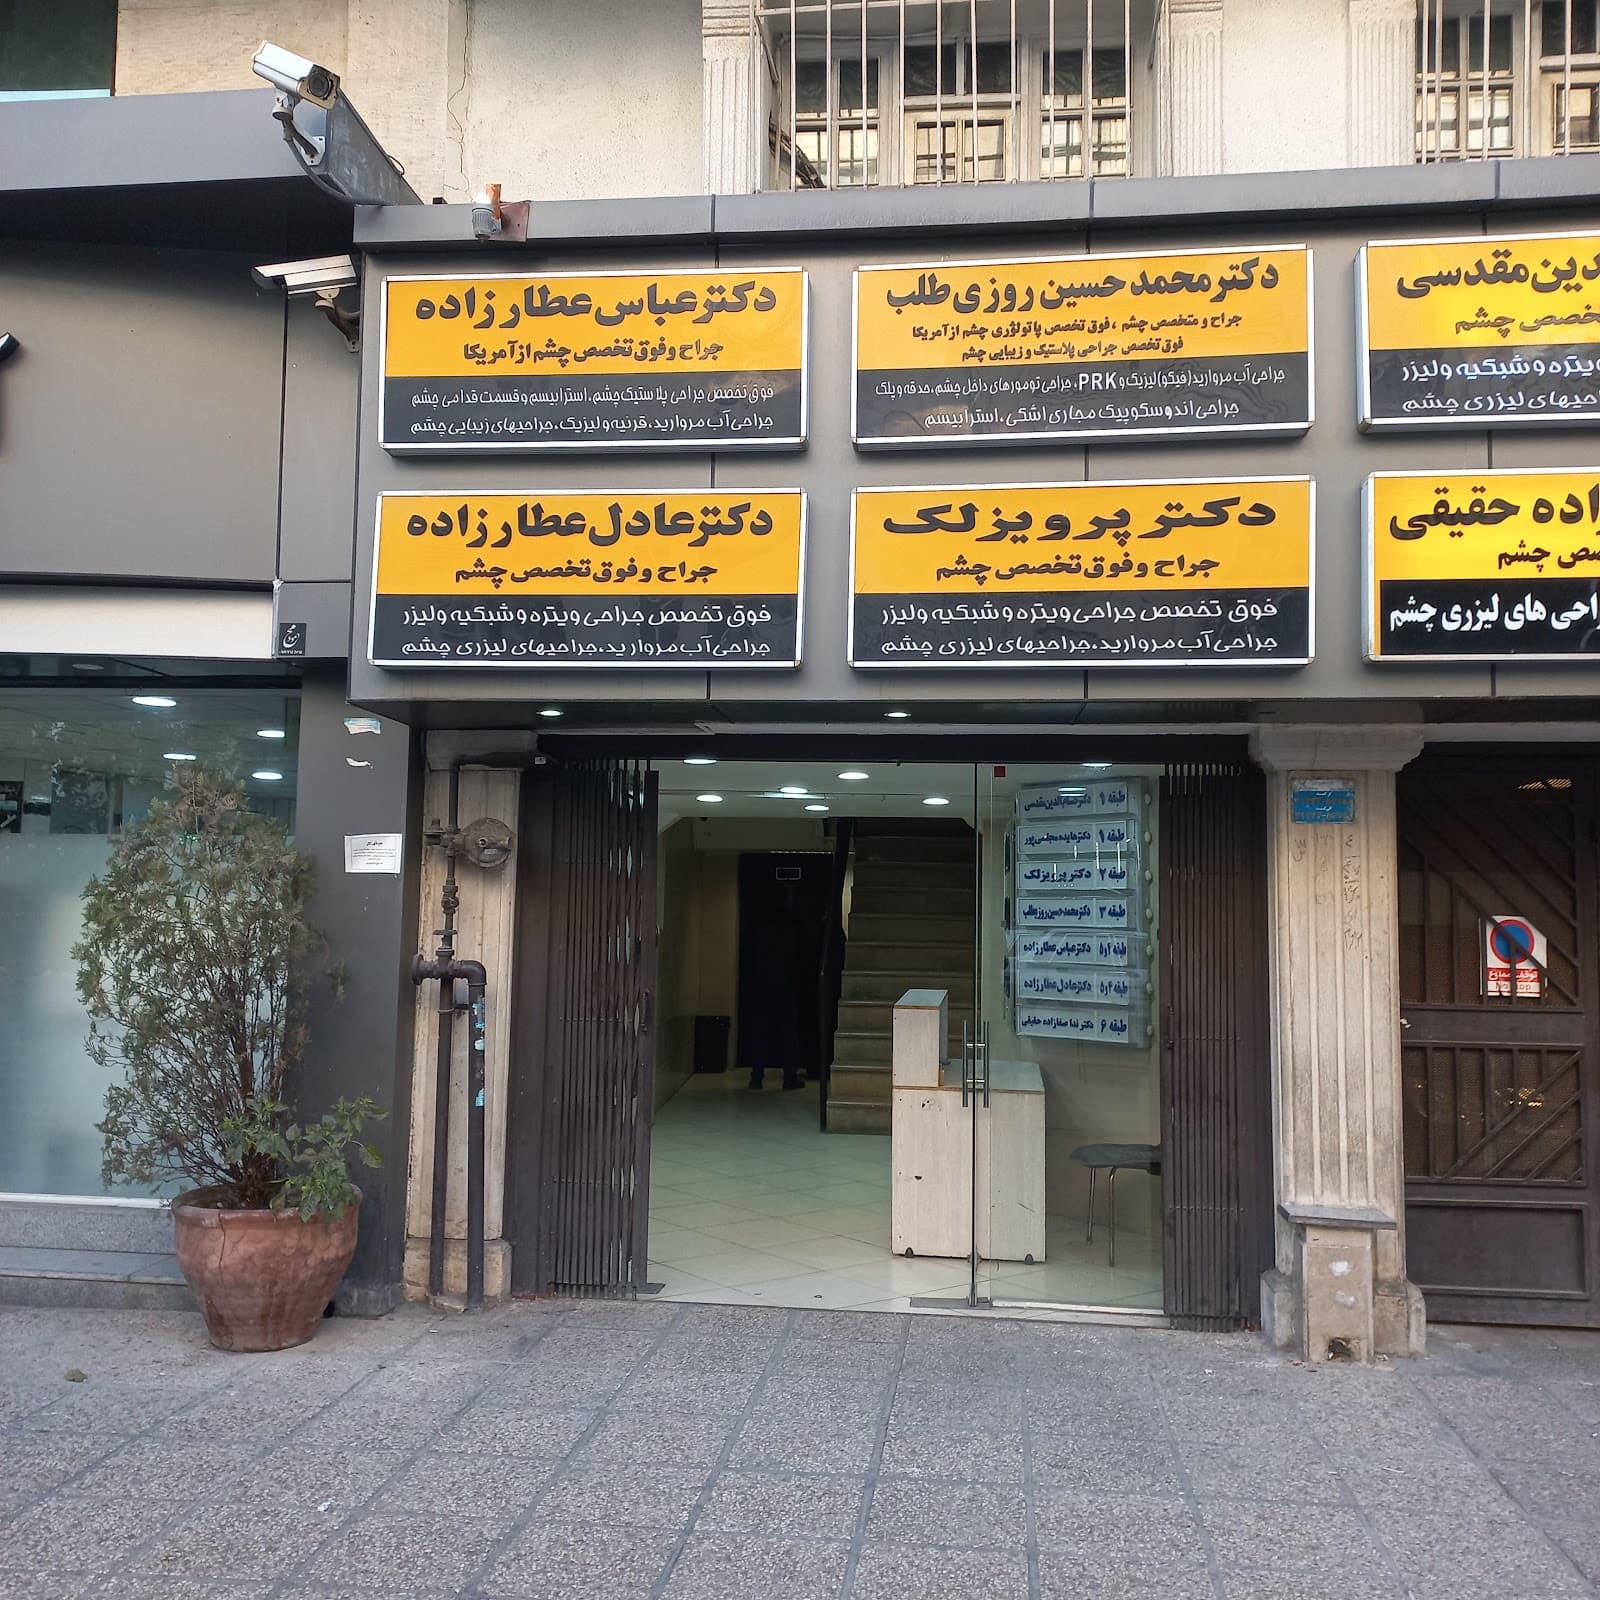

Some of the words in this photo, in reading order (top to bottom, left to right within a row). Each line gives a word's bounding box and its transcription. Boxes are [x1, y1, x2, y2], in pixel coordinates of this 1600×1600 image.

[1131, 270, 1212, 296] محمد
[1210, 256, 1279, 303] دکتر
[1397, 248, 1530, 299] مقدسی
[692, 280, 776, 324] دکتر
[1040, 275, 1126, 311] حسین
[594, 282, 698, 327] عباس
[1044, 320, 1085, 336] تخصص
[1151, 315, 1203, 331] متخصص
[1211, 312, 1242, 328] جراح
[1455, 306, 1516, 338] چشم
[962, 323, 989, 340] چشم
[534, 338, 571, 368] چشم
[573, 338, 635, 362] تخصص
[680, 338, 724, 361] جراح
[962, 347, 988, 363] چشم
[989, 345, 1024, 361] زیبایی
[1034, 342, 1075, 359] پلاستیک
[1077, 342, 1117, 357] جراحی
[1121, 338, 1160, 355] تخصص
[1162, 336, 1184, 353] فوق
[1252, 366, 1286, 385] جراحی
[1456, 355, 1530, 379] شبکیه
[671, 385, 705, 404] جراحی
[707, 385, 747, 404] تخصص
[748, 384, 774, 404] فوق
[963, 379, 988, 396] داخل
[1041, 376, 1071, 393] جراحی
[411, 388, 439, 410] چشم
[442, 389, 478, 408] قدامی
[621, 386, 667, 408] پلاستیک
[1402, 393, 1460, 414] چشم
[1464, 391, 1524, 411] لیزری
[1049, 406, 1096, 424] مجاری
[1196, 400, 1241, 419] جراحی
[411, 416, 446, 437] چشم
[448, 417, 490, 436] زیبایی
[611, 415, 647, 433] قرنیه
[731, 413, 774, 431] جراحی
[589, 502, 695, 547] عادل
[687, 502, 773, 547] دکتر
[883, 502, 980, 535] لک
[1137, 496, 1277, 540] دکتر
[1389, 486, 1521, 542] حقیقی
[972, 507, 1133, 548] پرویز
[995, 554, 1082, 580] تخصص
[1154, 554, 1220, 578] جراح
[1498, 540, 1551, 573] چشم
[455, 557, 508, 589] چشم
[510, 559, 592, 583] تخصص
[657, 561, 718, 584] جراح
[936, 554, 992, 587] چشم
[450, 603, 515, 626] شبکیه
[529, 606, 581, 626] ویتره
[583, 605, 645, 626] جراحی
[648, 605, 724, 626] تخصص
[726, 604, 772, 628] فوق
[931, 601, 1000, 625] شبکیه
[1017, 603, 1071, 625] ویتره
[1073, 601, 1137, 624] جراحی
[1140, 600, 1222, 622] تخصص
[1227, 598, 1278, 622] فوق
[1389, 595, 1438, 632] چشم
[1441, 592, 1500, 632] لیزری
[1504, 592, 1547, 631] های
[401, 636, 451, 658] چشم
[456, 638, 508, 656] لیزری
[712, 639, 771, 657] جراحی
[881, 635, 934, 657] چشم
[939, 637, 994, 656] لیزری
[1213, 634, 1279, 652] جراحی
[1068, 867, 1092, 882] دکتر
[1107, 904, 1126, 921] طبقه
[1075, 943, 1091, 957] دکتر
[1074, 980, 1092, 995] دکتر
